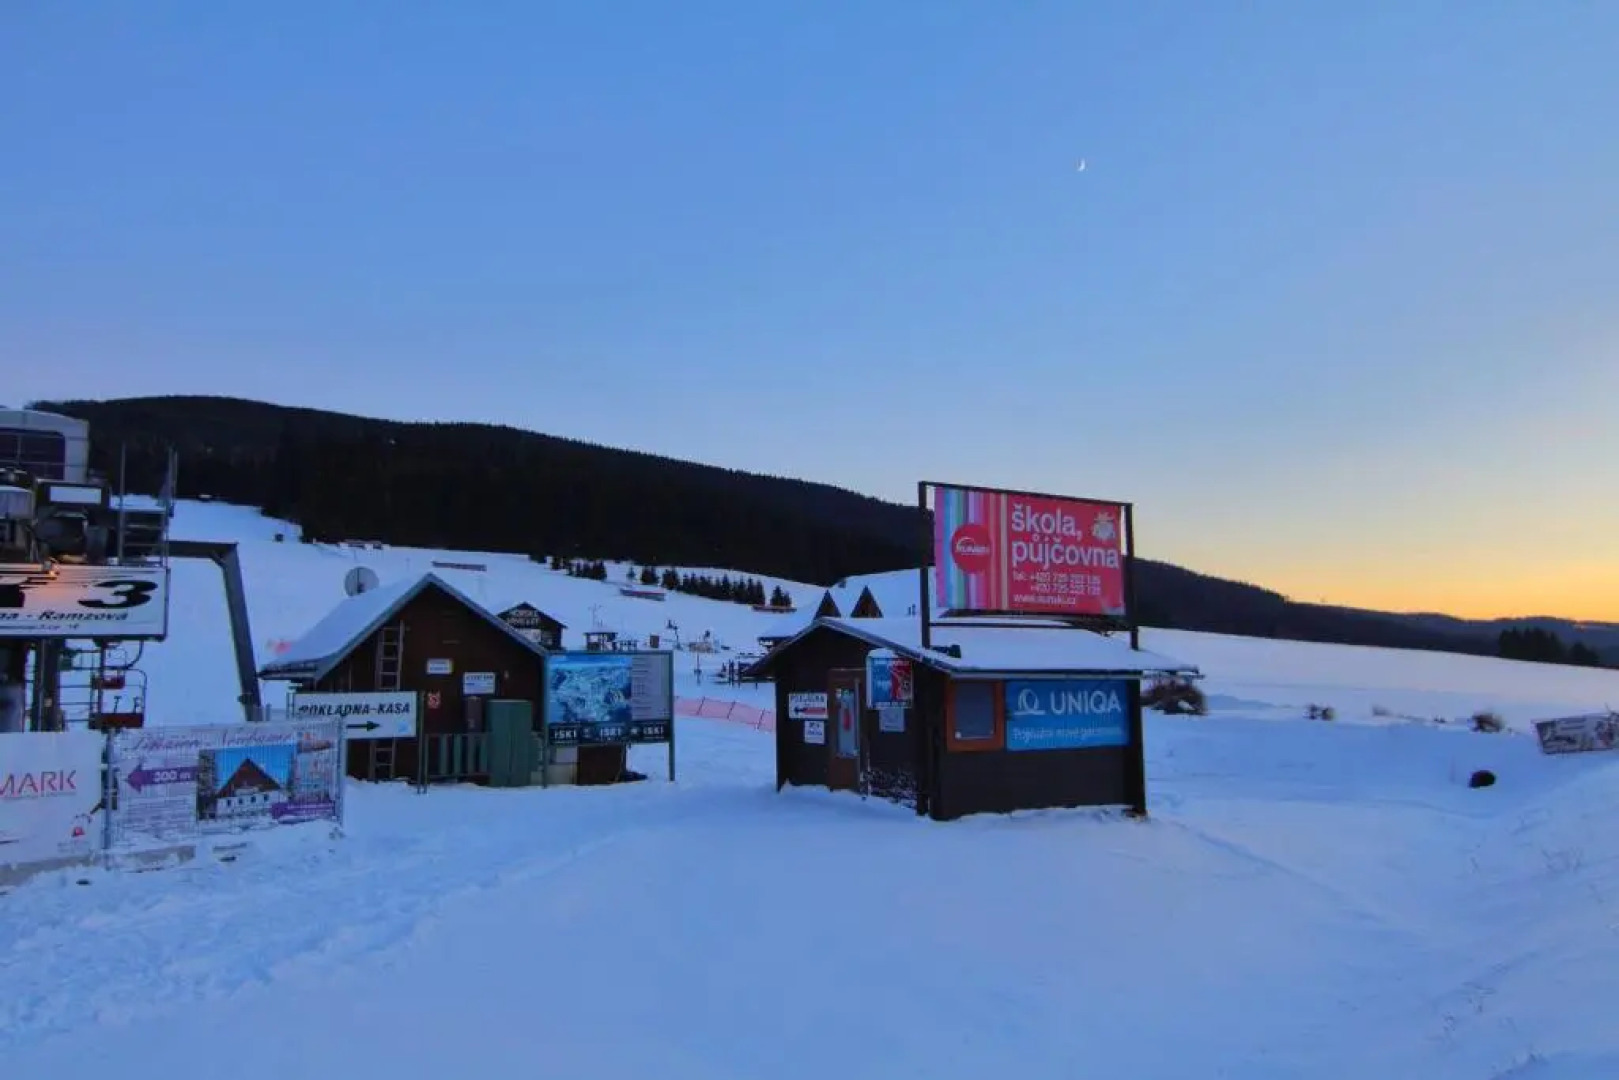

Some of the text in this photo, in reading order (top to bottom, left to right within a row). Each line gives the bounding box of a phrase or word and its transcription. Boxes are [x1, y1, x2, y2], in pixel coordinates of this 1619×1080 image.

[1011, 504, 1083, 541] škola,
[1011, 534, 1119, 571] půjčovna
[77, 580, 158, 608] 3
[1050, 690, 1122, 715] UNIQA
